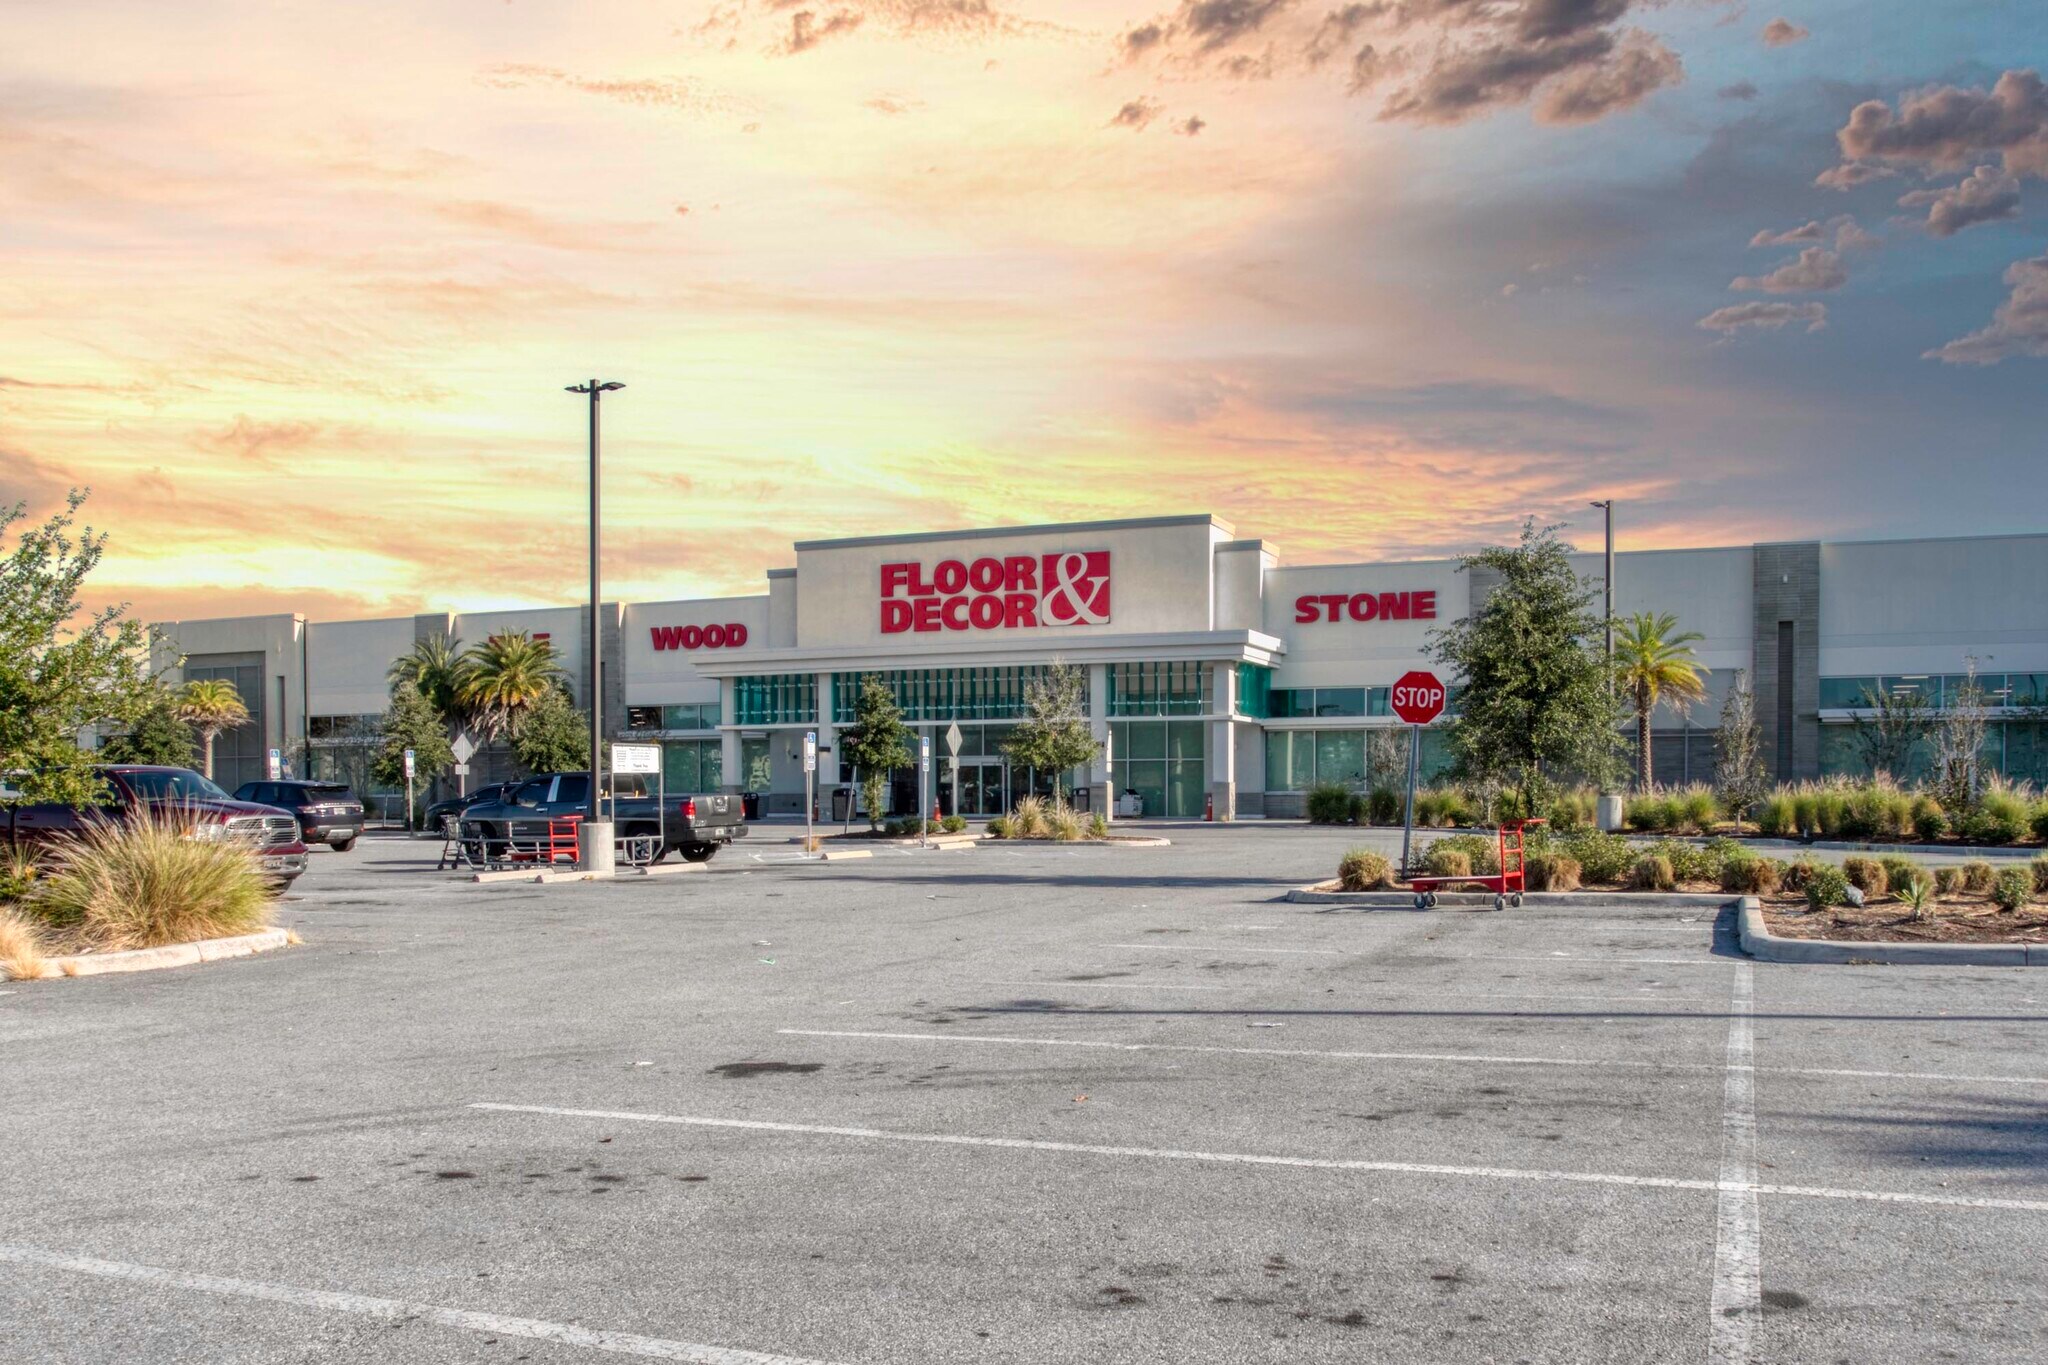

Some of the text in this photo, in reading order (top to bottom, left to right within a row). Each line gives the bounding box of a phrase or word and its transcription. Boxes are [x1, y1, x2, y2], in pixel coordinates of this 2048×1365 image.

[880, 552, 1111, 626] FLOOR &
[880, 593, 1038, 634] DECOR
[1295, 591, 1437, 624] STONE
[650, 623, 748, 651] WOOD
[1394, 686, 1442, 709] STOP
